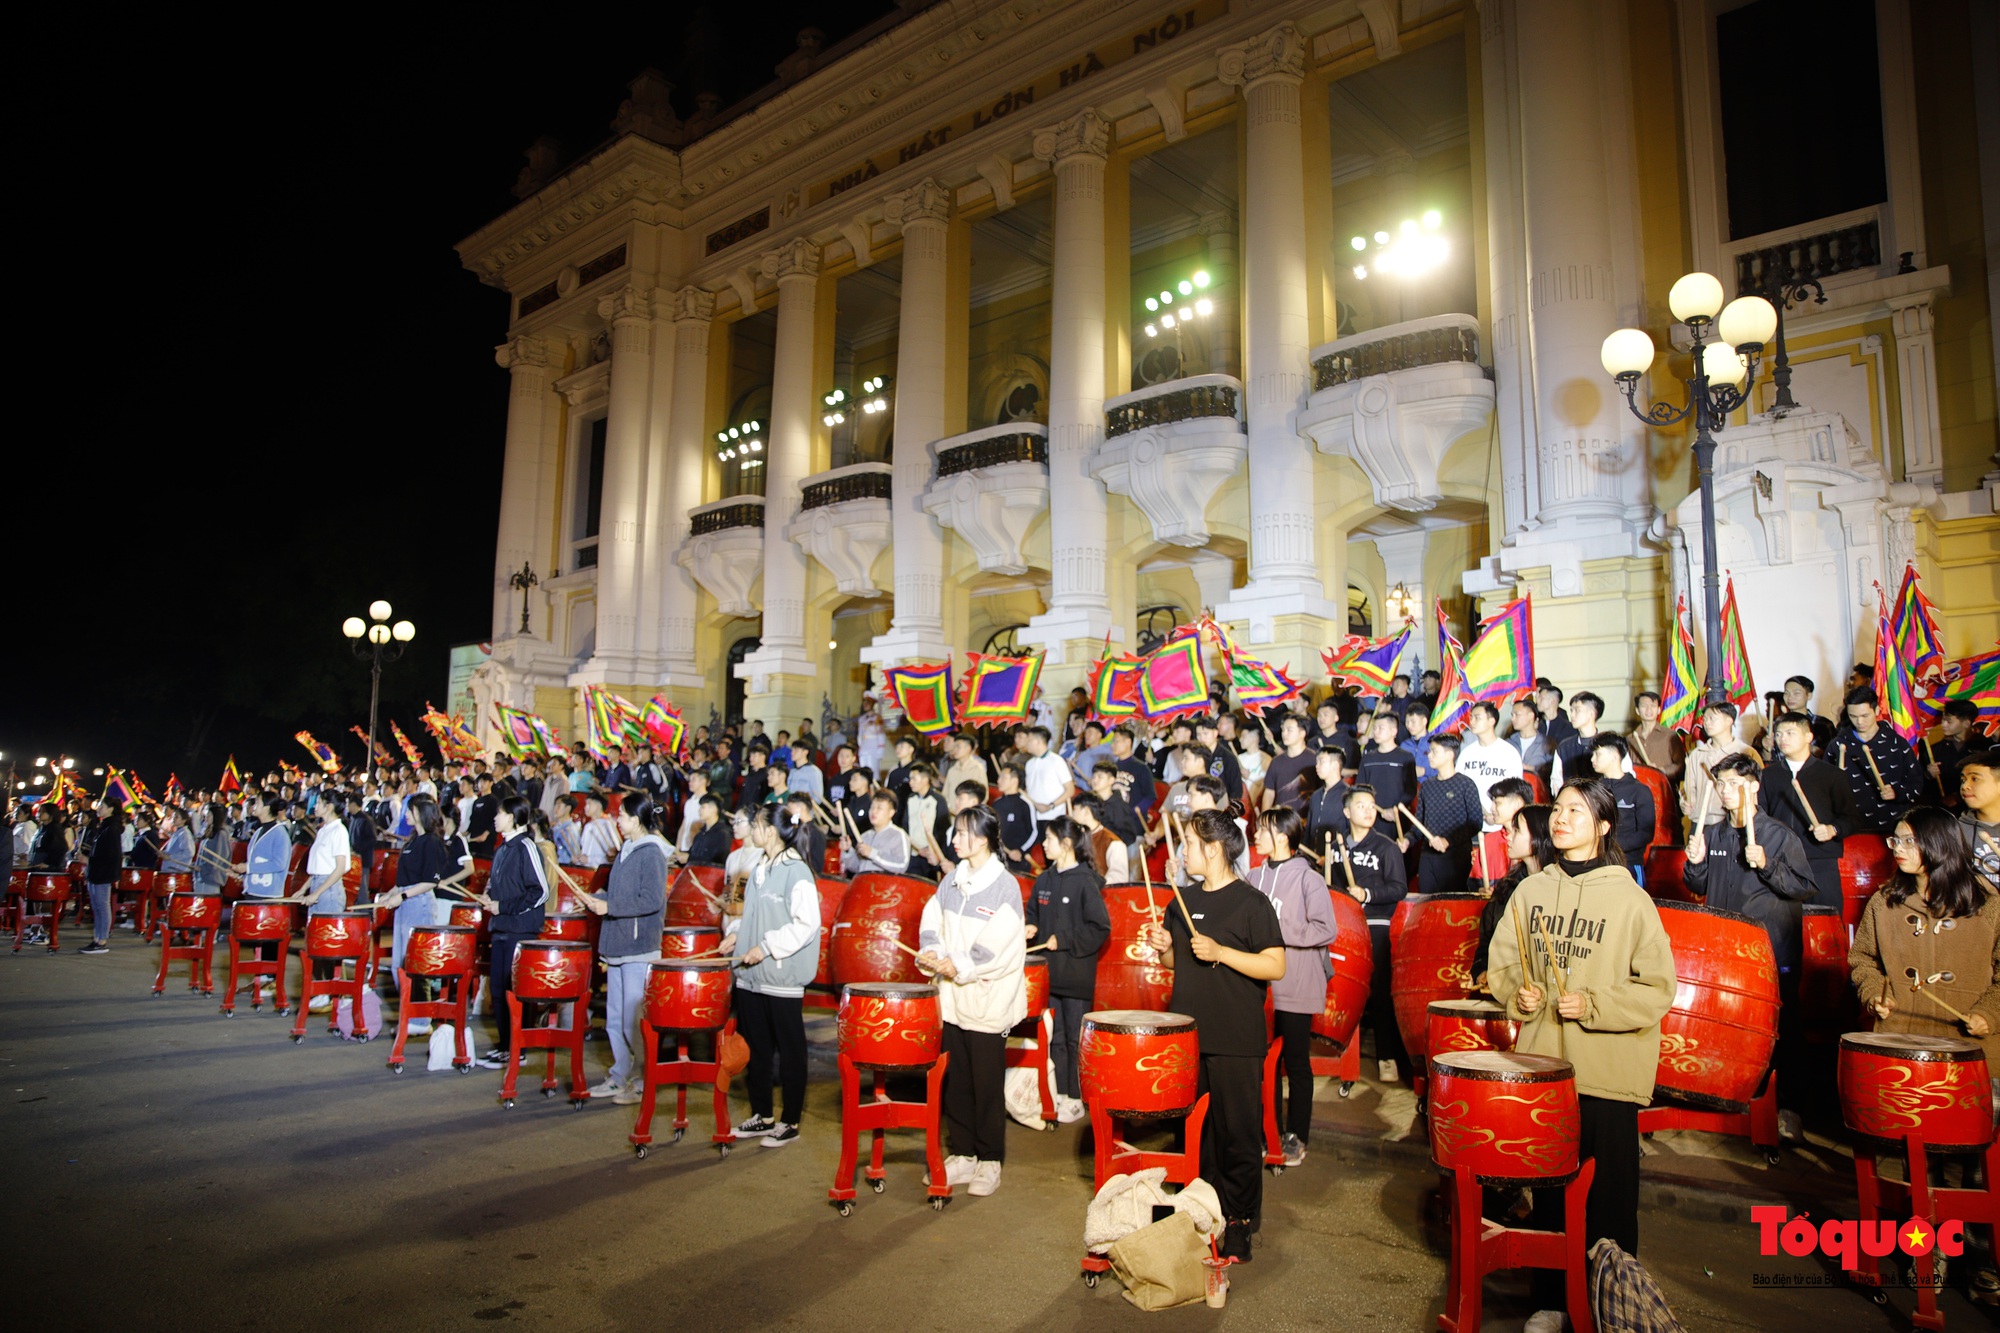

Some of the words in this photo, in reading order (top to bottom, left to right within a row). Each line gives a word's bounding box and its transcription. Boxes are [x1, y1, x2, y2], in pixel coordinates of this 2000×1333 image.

[900, 126, 952, 164] HÁT
[1059, 53, 1104, 88] HÀ
[1464, 761, 1487, 770] NEW
[1480, 767, 1506, 777] YORK
[1530, 905, 1564, 935] Bon
[1565, 908, 1607, 944] Jovi
